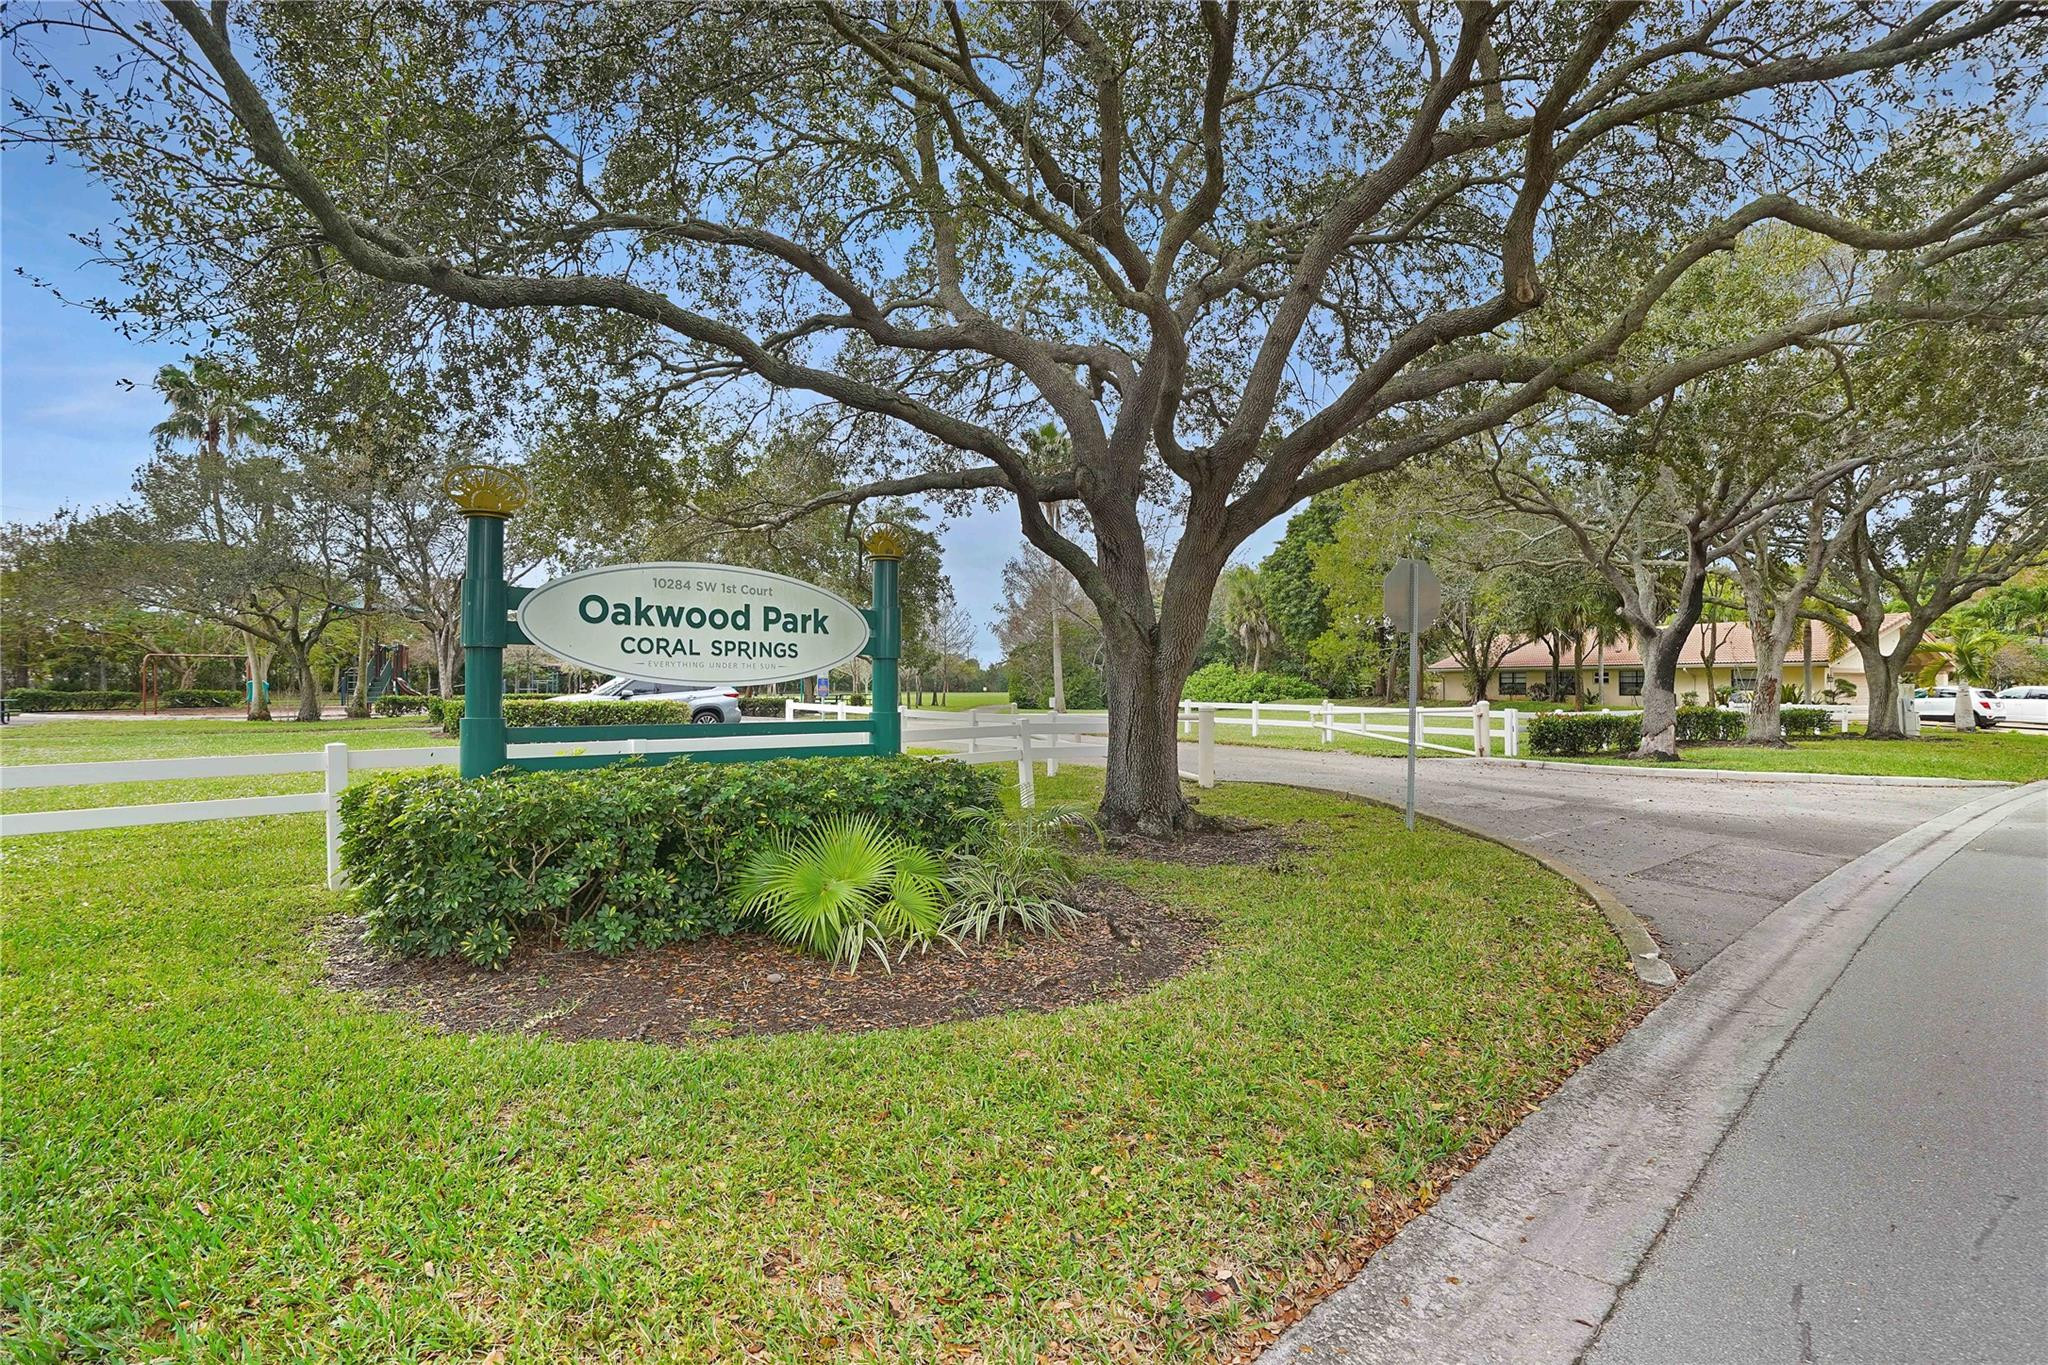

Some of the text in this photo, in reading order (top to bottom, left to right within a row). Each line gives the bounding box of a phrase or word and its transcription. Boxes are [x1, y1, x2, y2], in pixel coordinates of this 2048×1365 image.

[652, 577, 773, 597] 10284 SW 1st Court
[579, 594, 829, 635] Oakwood Park
[620, 637, 798, 659] CORAL SPRINGS
[648, 661, 705, 669] EVERYTHING
